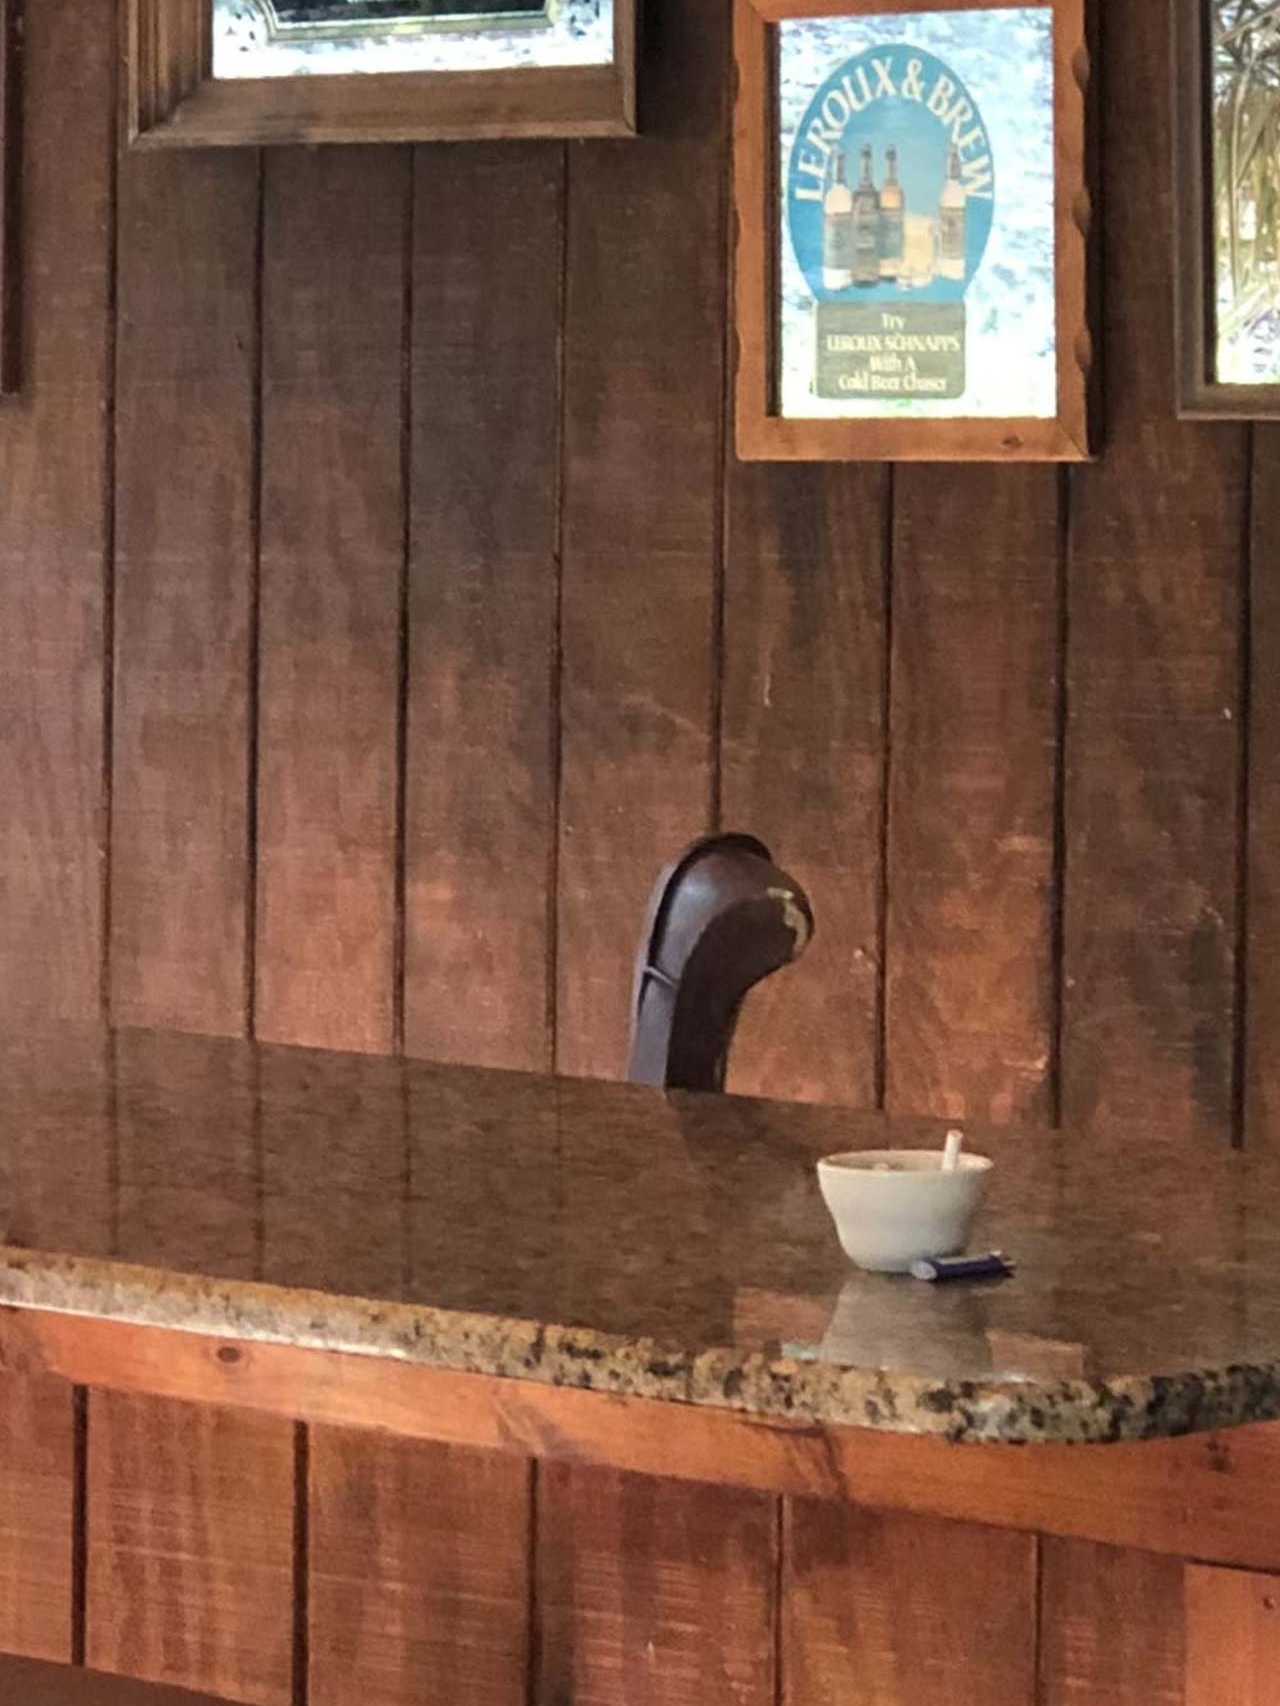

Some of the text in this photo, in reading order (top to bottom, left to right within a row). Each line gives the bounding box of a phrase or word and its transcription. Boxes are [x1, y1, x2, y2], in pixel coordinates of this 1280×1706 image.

[794, 56, 992, 201] LEROUX & BREW
